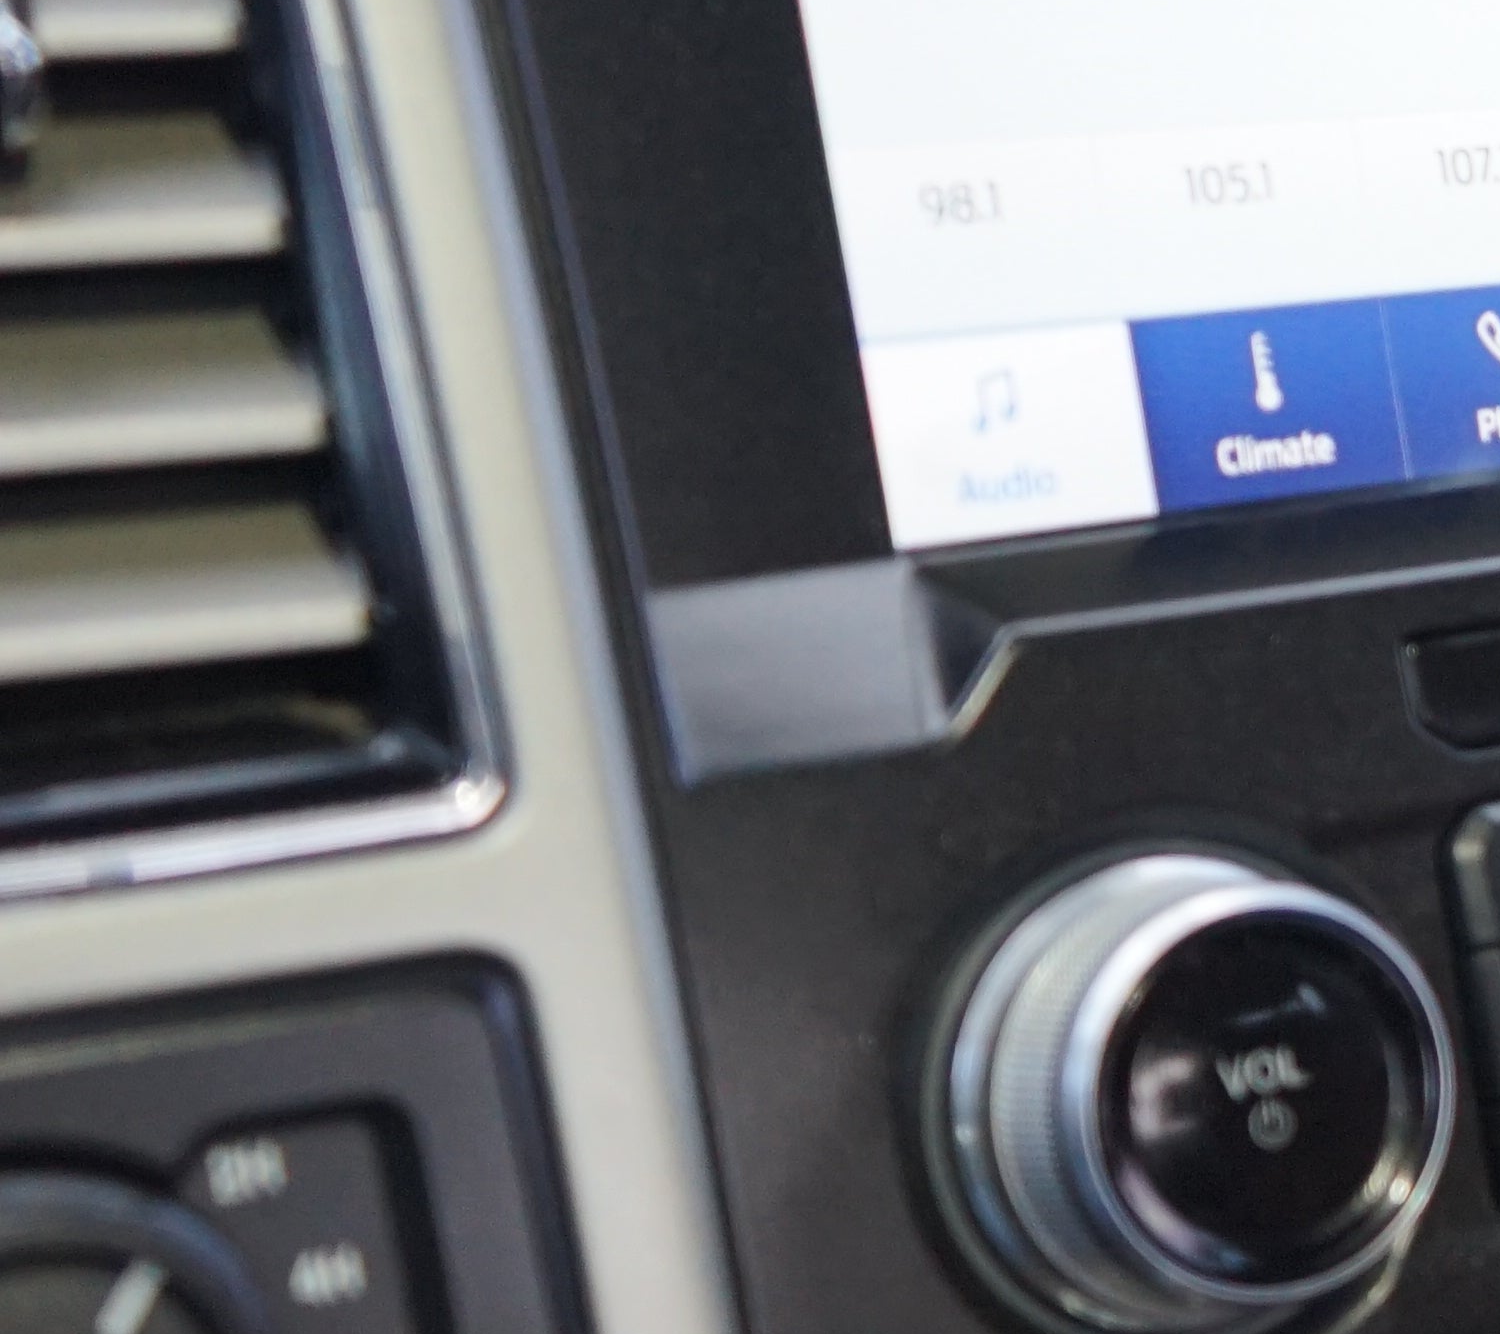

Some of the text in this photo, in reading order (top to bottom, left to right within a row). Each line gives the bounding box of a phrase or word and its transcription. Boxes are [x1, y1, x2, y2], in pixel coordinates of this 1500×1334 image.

[1185, 161, 1274, 205] 105.1
[1215, 430, 1337, 478] Climate
[1216, 1044, 1310, 1103] VOL
